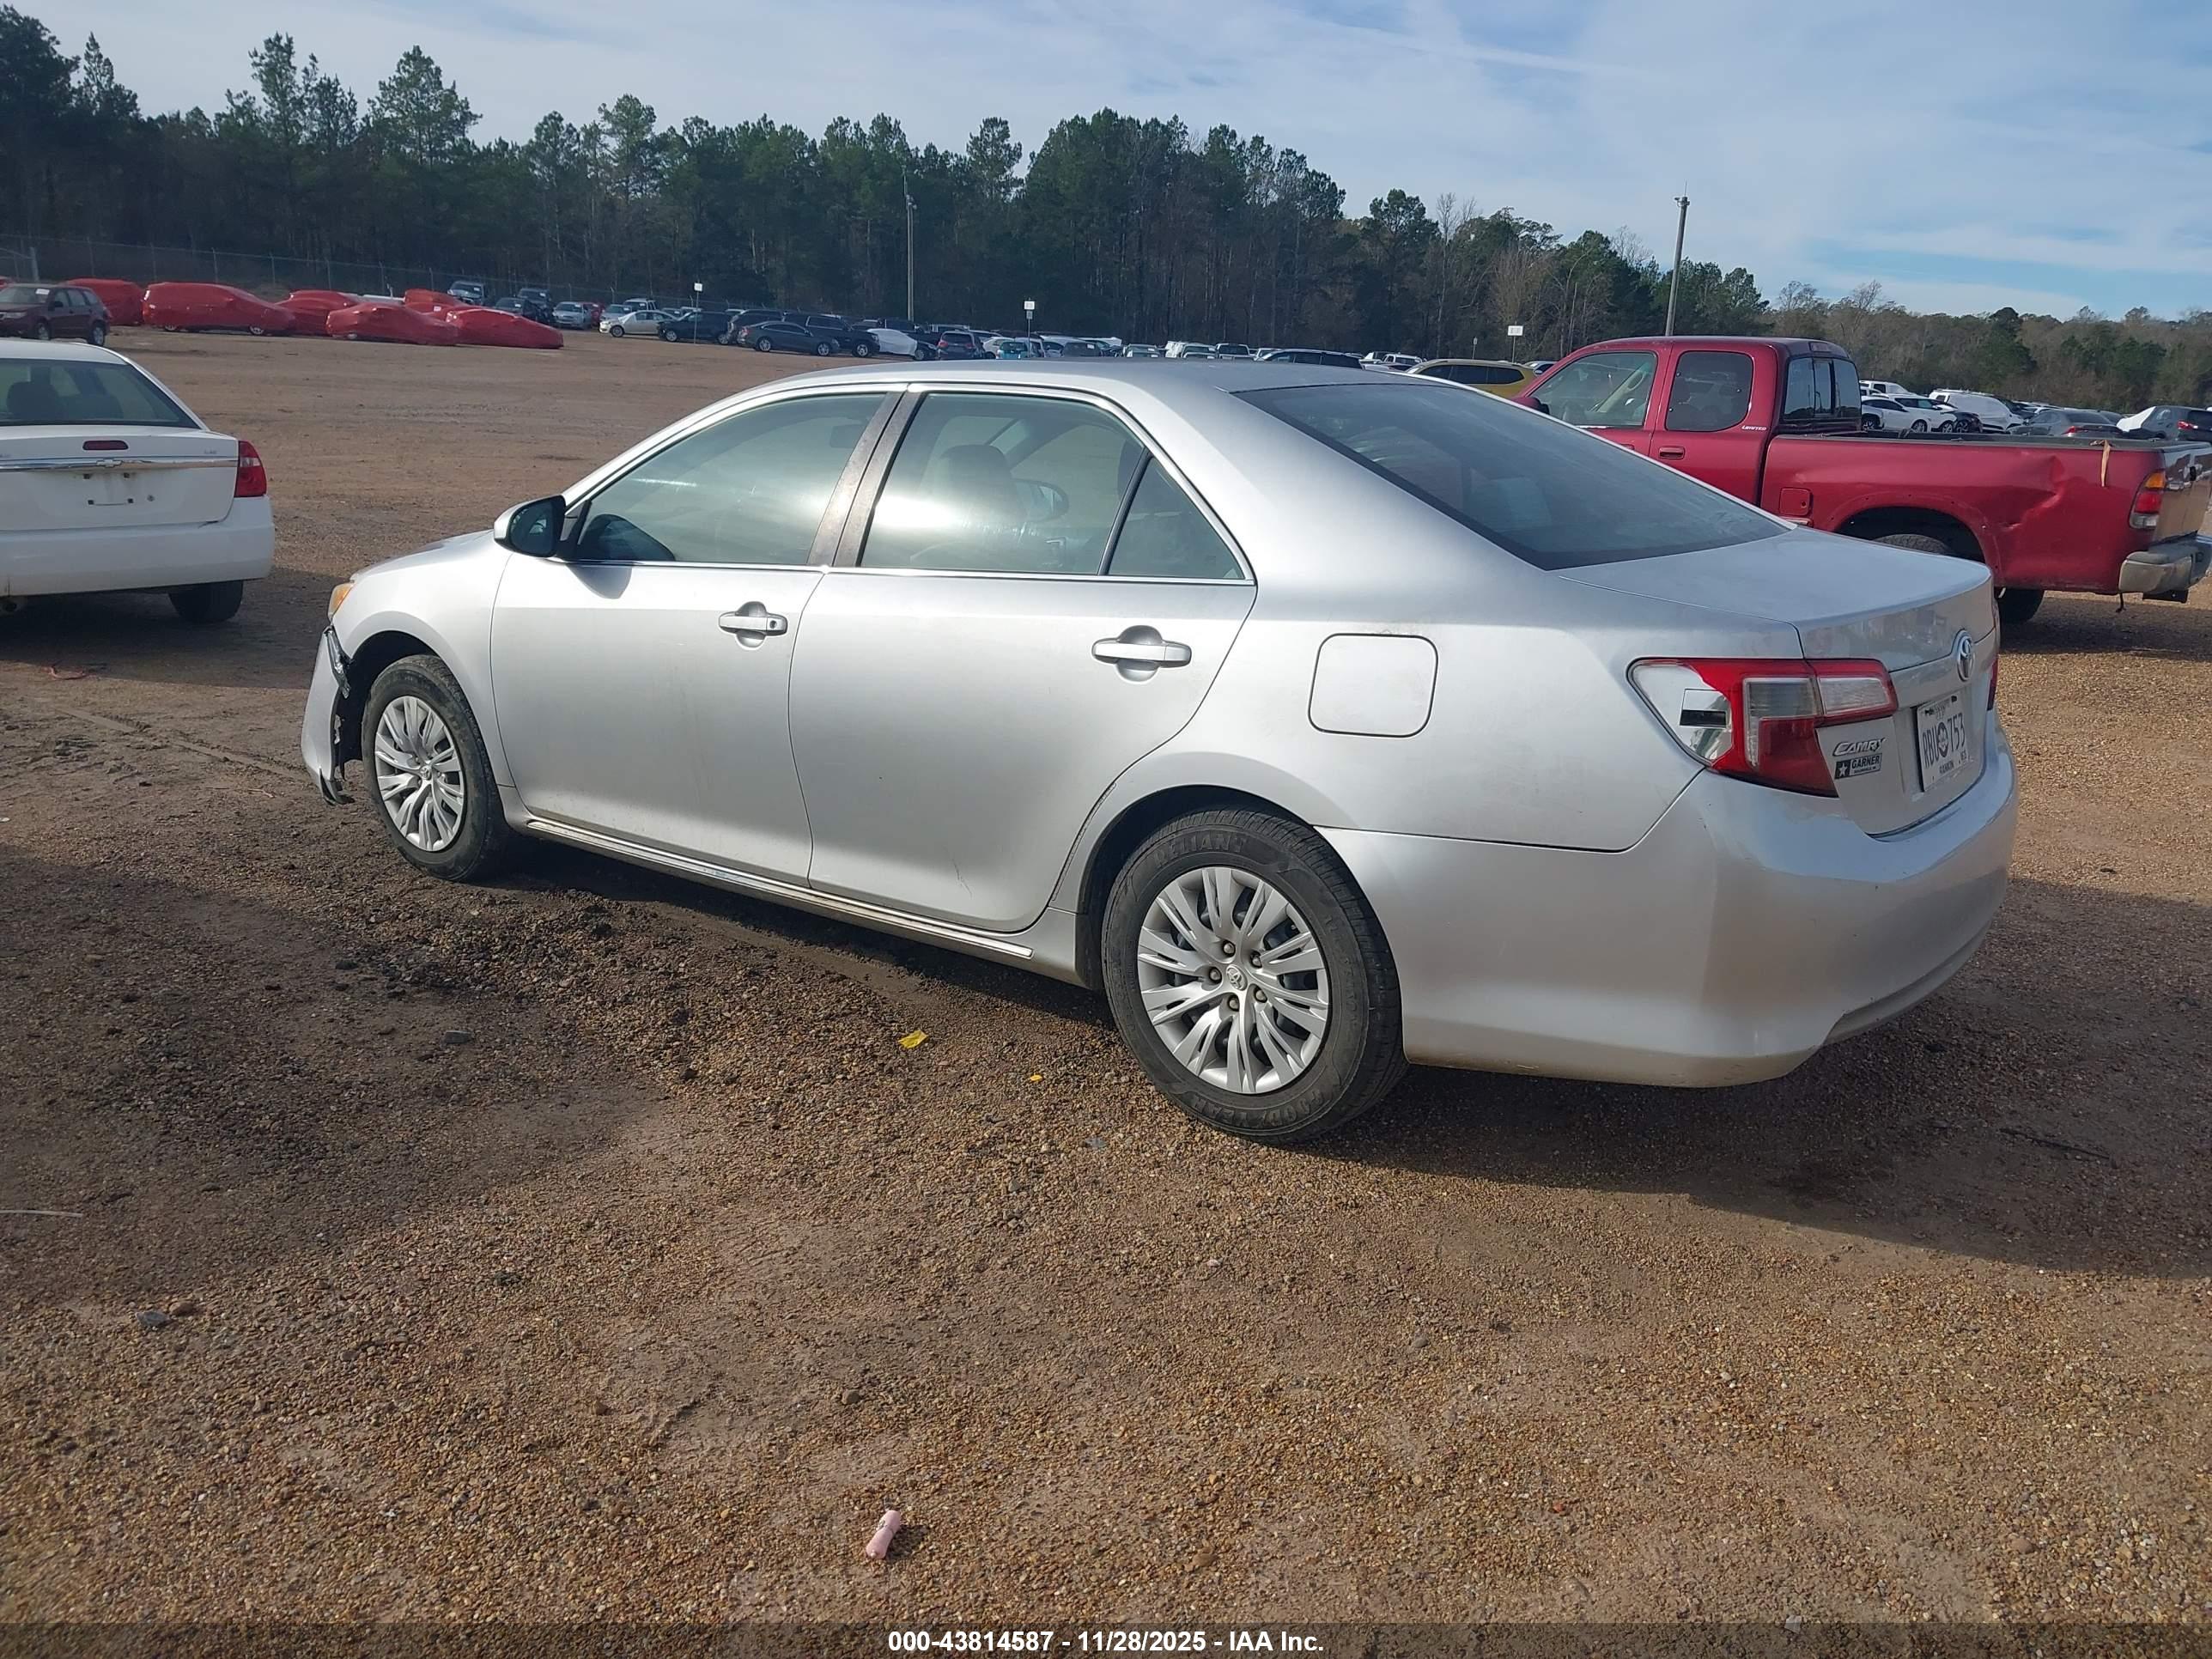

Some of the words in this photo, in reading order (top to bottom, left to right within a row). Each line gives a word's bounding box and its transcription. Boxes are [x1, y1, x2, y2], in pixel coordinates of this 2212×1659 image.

[1948, 712, 1965, 752] 753
[1832, 737, 1887, 757] CAMRY
[1852, 756, 1880, 769] GARNER
